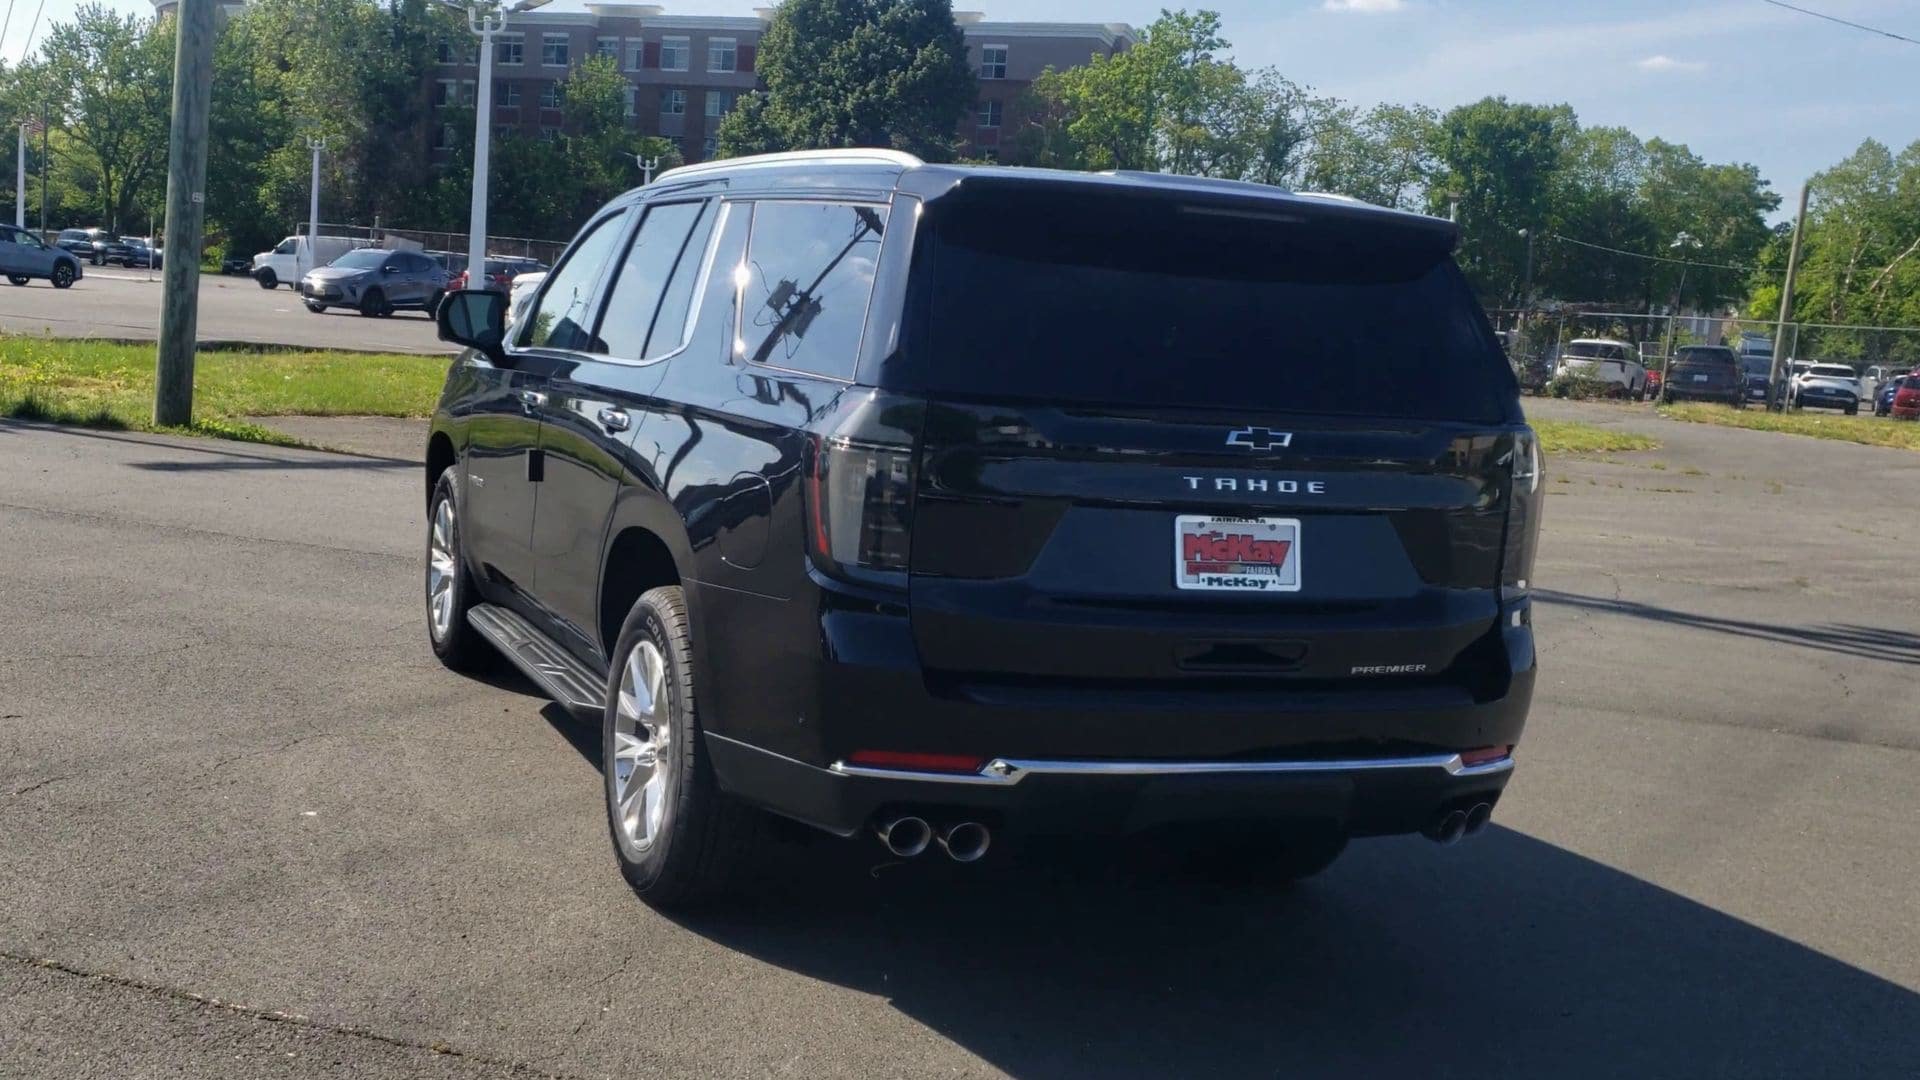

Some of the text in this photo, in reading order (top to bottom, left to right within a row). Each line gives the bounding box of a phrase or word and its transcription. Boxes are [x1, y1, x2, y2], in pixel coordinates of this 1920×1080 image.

[1183, 476, 1325, 493] TAHOE
[1183, 534, 1292, 567] McKay
[1207, 576, 1269, 589] McKay
[1351, 664, 1427, 675] PREMIER
